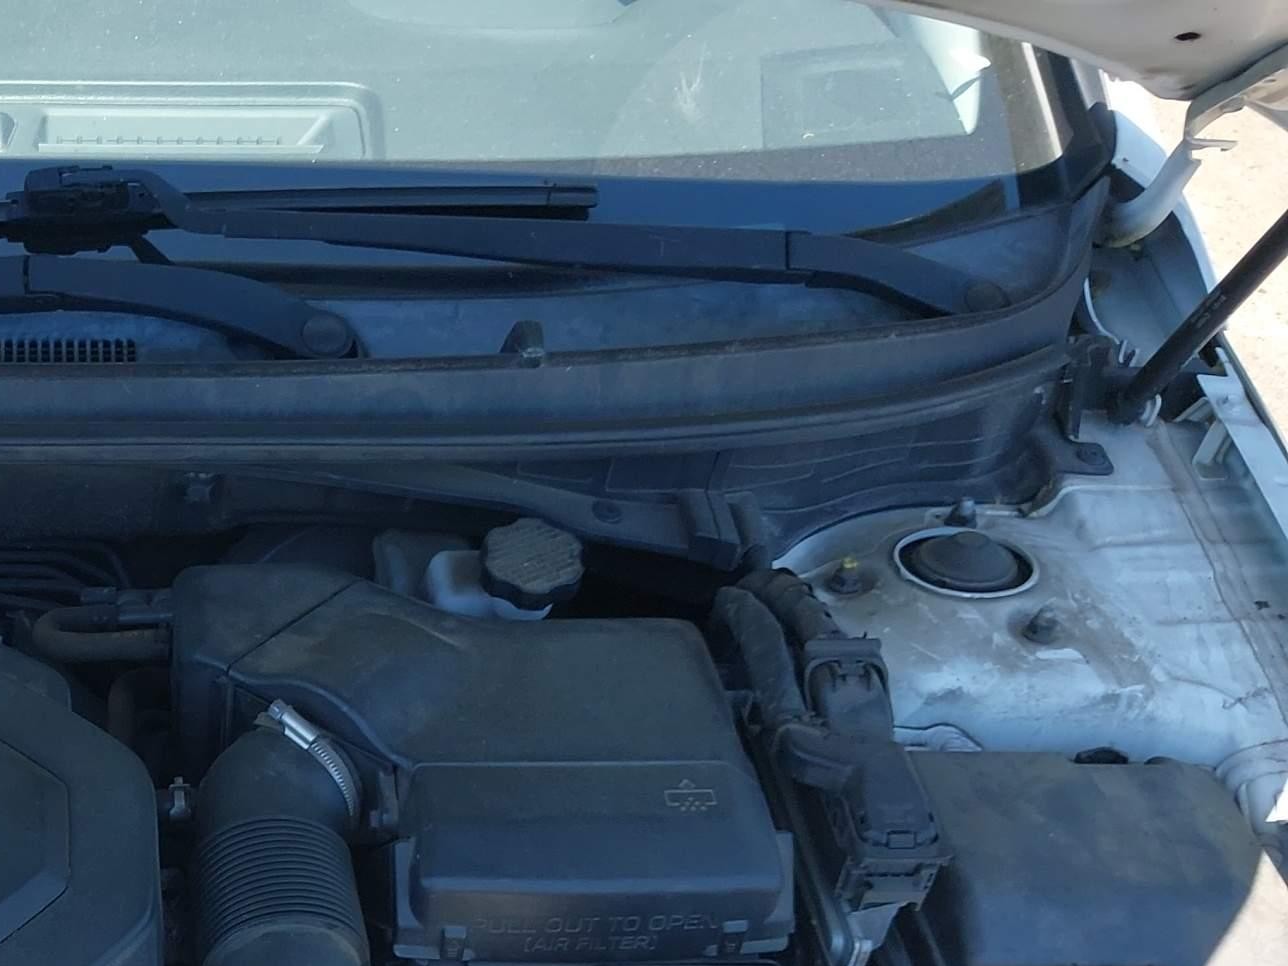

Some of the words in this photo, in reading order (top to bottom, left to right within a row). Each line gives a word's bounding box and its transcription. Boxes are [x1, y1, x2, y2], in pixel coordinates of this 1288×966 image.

[471, 917, 536, 934] PULL
[543, 916, 601, 934] OUT
[607, 915, 641, 932] TO
